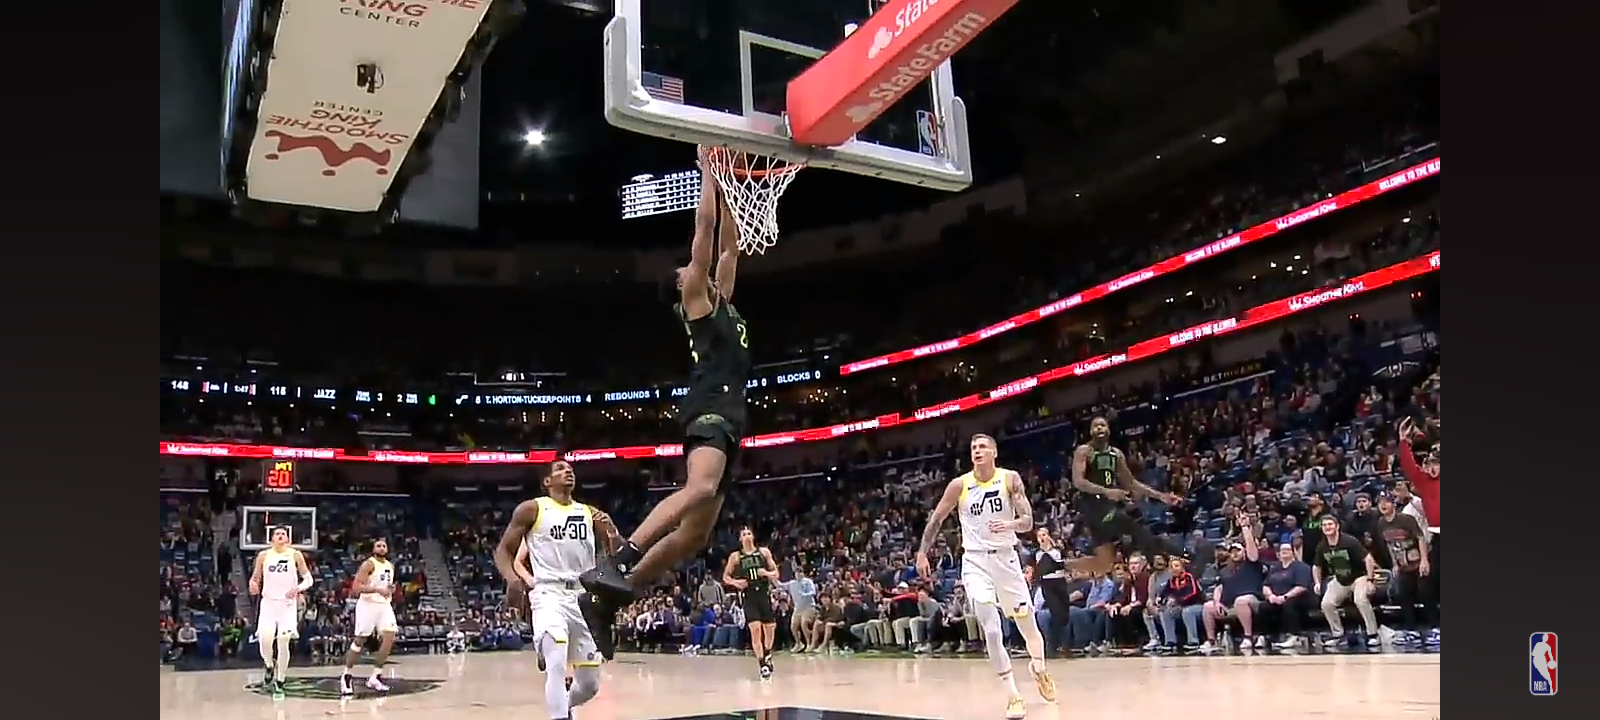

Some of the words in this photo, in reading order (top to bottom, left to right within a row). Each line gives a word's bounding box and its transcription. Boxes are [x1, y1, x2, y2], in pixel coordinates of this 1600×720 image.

[339, 7, 421, 28] CENTER
[313, 100, 383, 117] CENTER
[265, 114, 409, 145] SMOOTHIE
[586, 395, 592, 403] 4
[604, 390, 650, 402] REBOUNDS
[654, 389, 660, 398] 1
[761, 378, 767, 387] 0
[776, 371, 810, 384] BLOCKS
[814, 370, 821, 379] 0
[313, 388, 336, 399] JAZZ
[377, 392, 383, 401] 3
[397, 394, 403, 403] 2
[268, 470, 290, 487] 20
[1104, 471, 1112, 485] 8
[989, 497, 1003, 513] 19
[568, 522, 587, 540] 30
[276, 563, 289, 574] 24
[749, 568, 758, 580] 11
